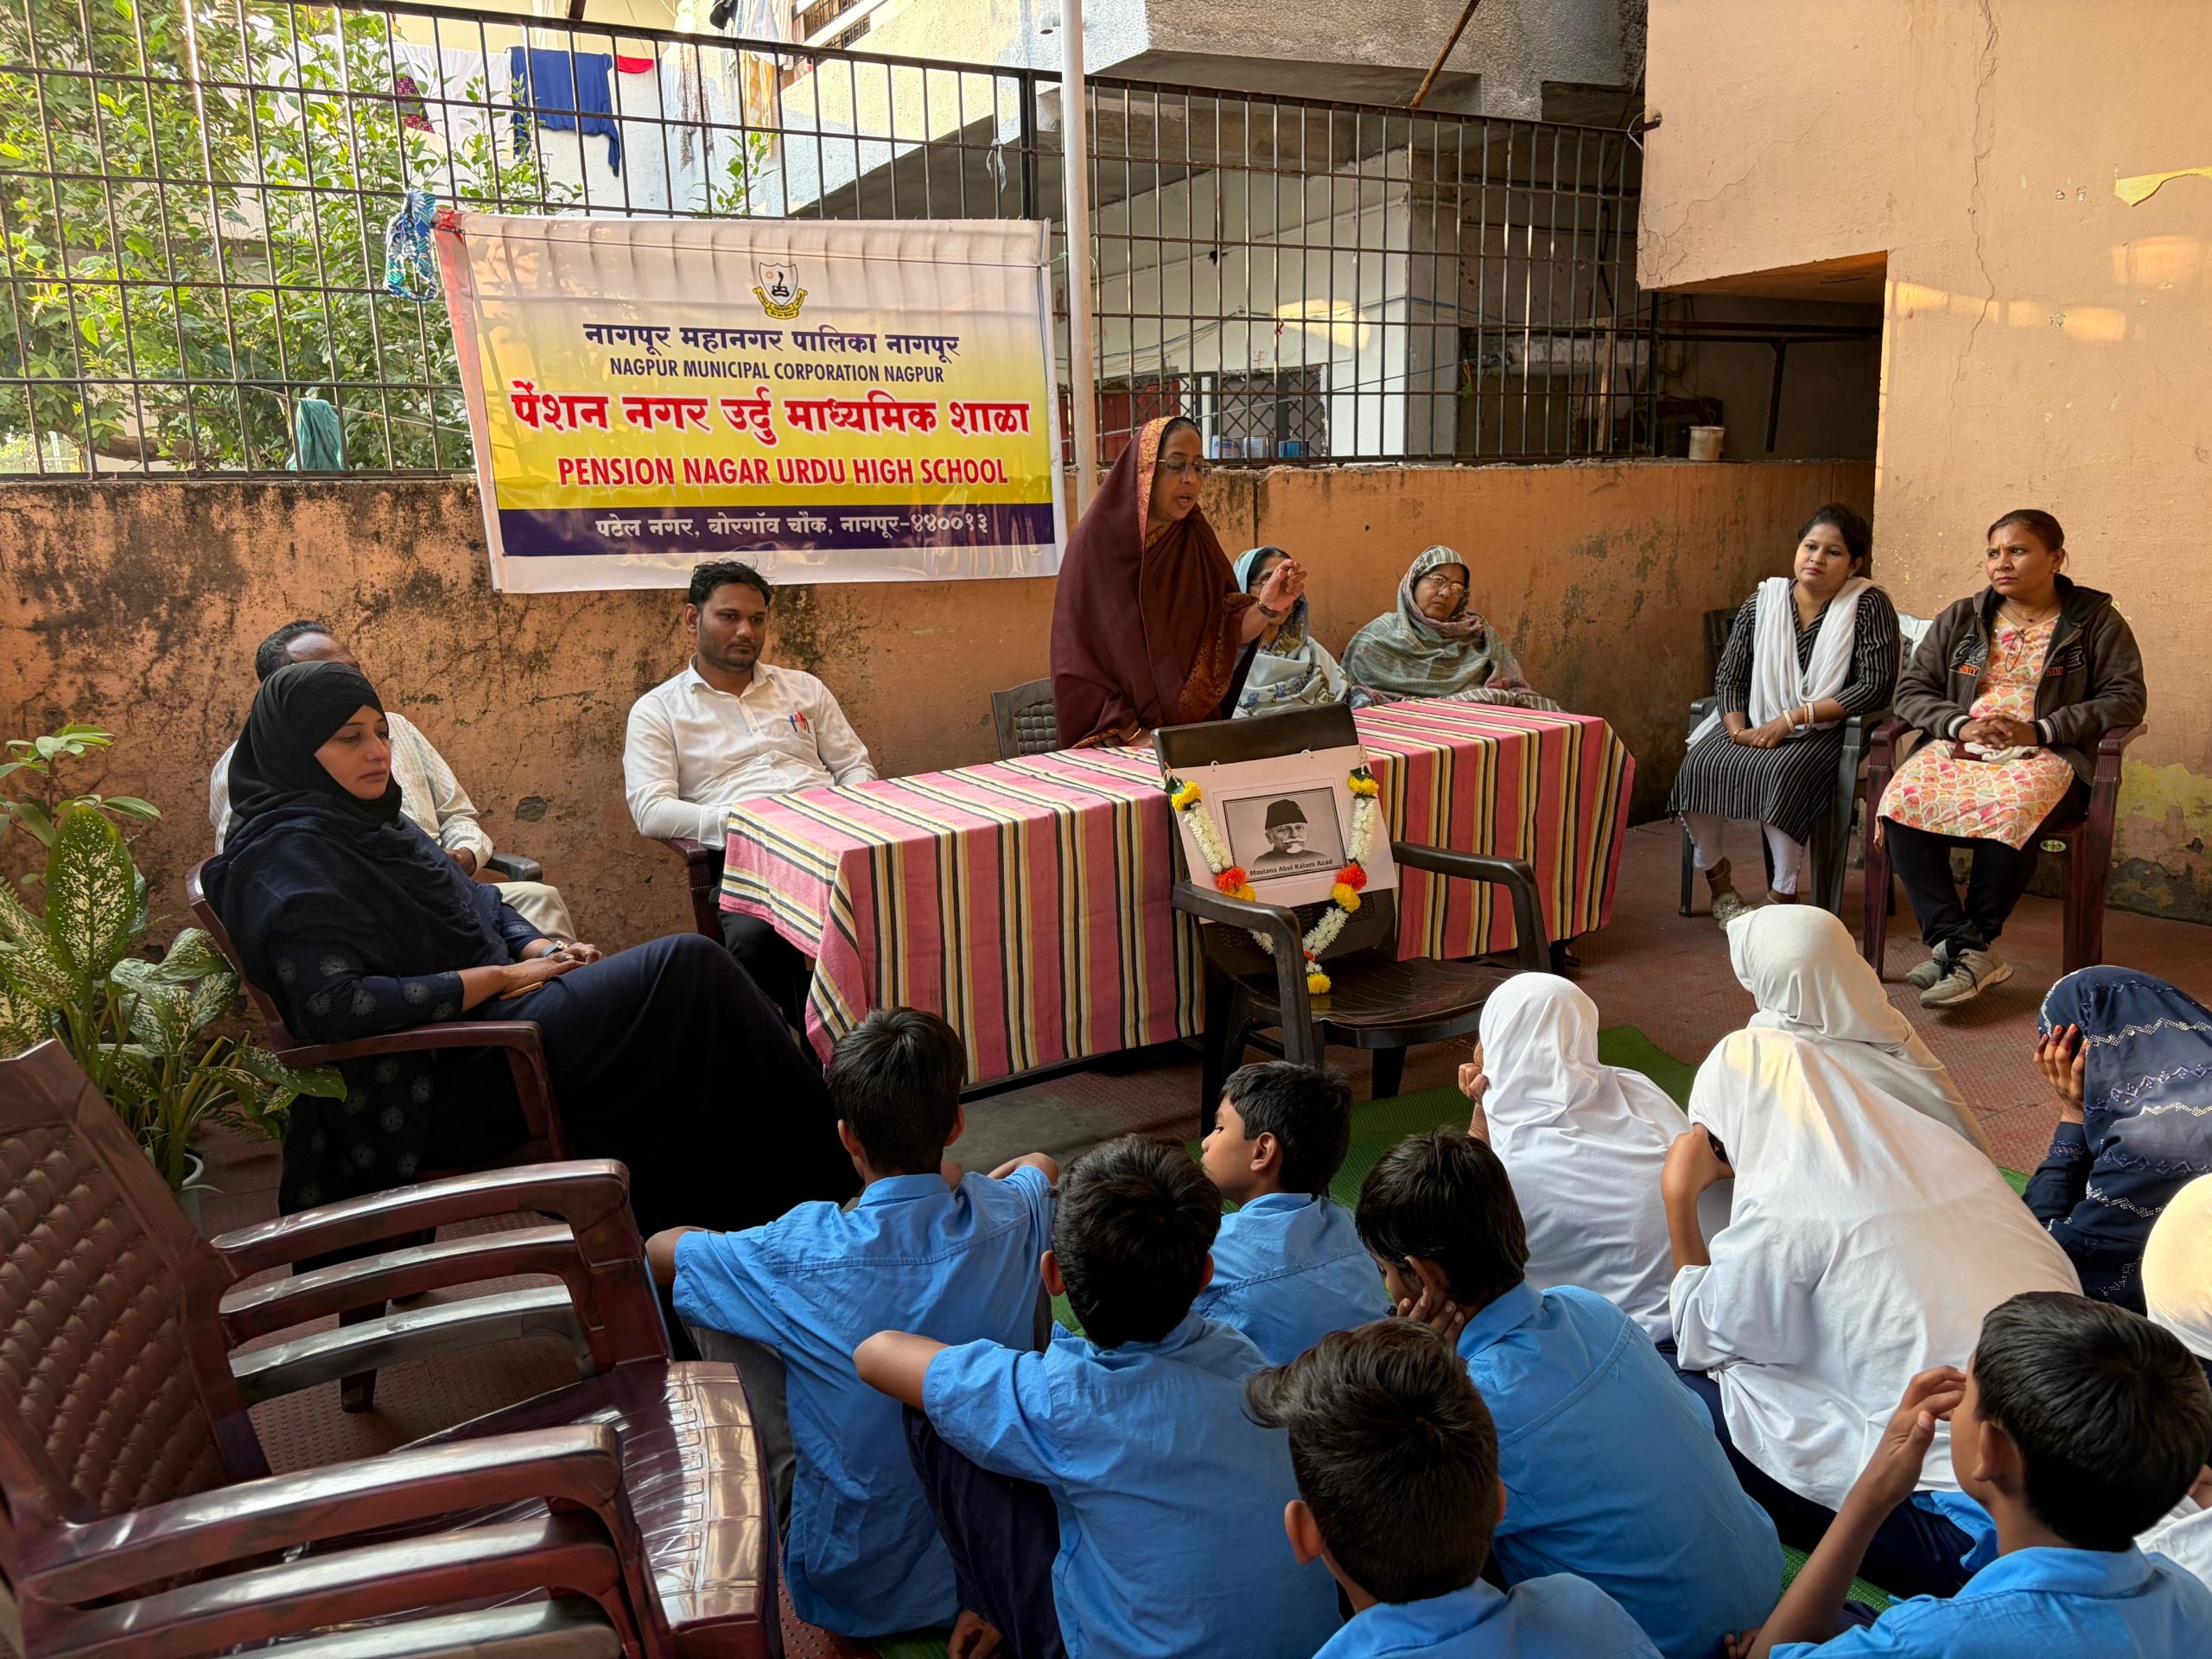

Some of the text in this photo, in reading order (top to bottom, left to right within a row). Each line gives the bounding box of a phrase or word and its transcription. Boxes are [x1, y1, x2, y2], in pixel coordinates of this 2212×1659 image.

[583, 323, 961, 364] नागपूर महानगर पालिका नागपूर
[610, 358, 944, 383] NAGPUR MUNICIPAL CORPORATION NAGPUR
[511, 380, 1030, 446] पेंशन नगर उर्दु माध्यमिक शाळा
[557, 457, 1008, 486] PENSION NAGAR URDU HIGH SCHOOL
[595, 512, 641, 537] पटेल
[648, 518, 701, 537] नगर,
[786, 511, 833, 536] चौक,
[1249, 867, 1277, 876] Maulana
